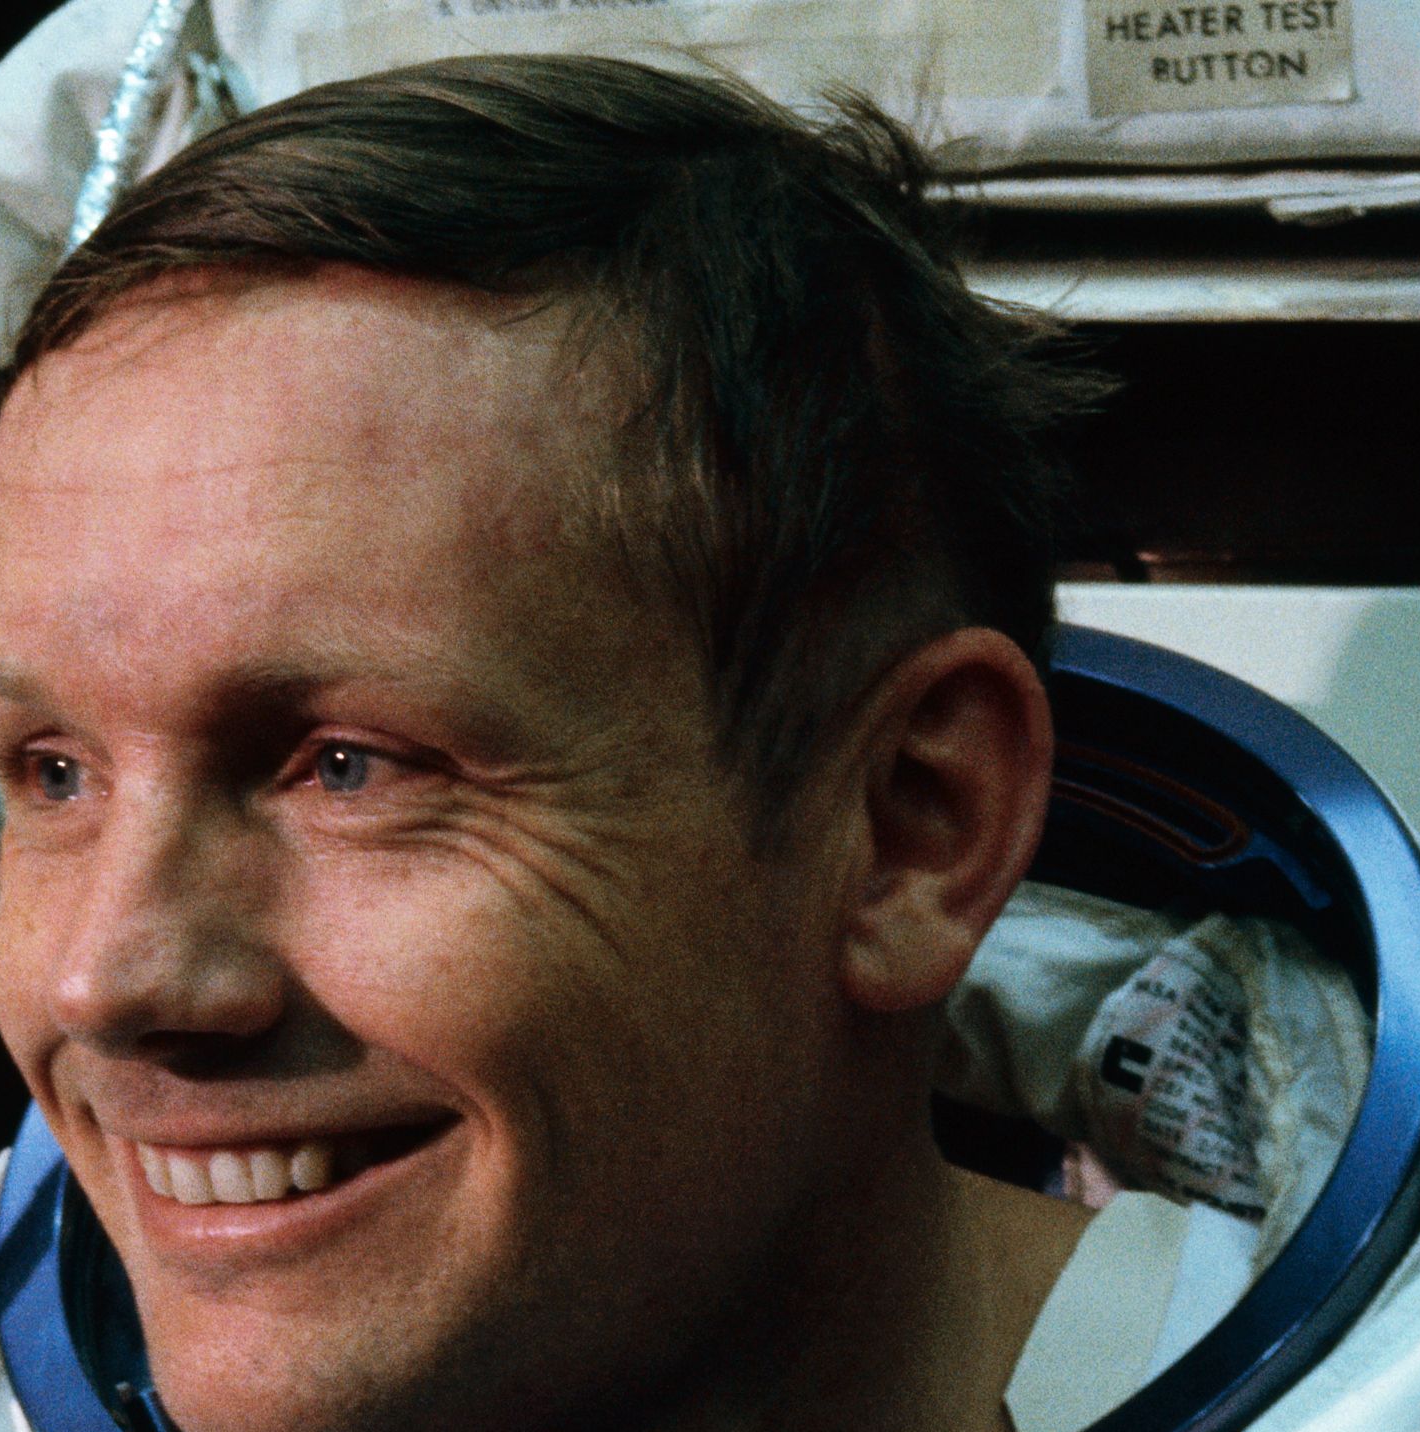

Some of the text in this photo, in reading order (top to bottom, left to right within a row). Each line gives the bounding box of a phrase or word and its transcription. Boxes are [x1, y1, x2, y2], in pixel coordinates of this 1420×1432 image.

[1104, 0, 1341, 42] HEATER TEST
[1151, 49, 1308, 86] BUTTON
